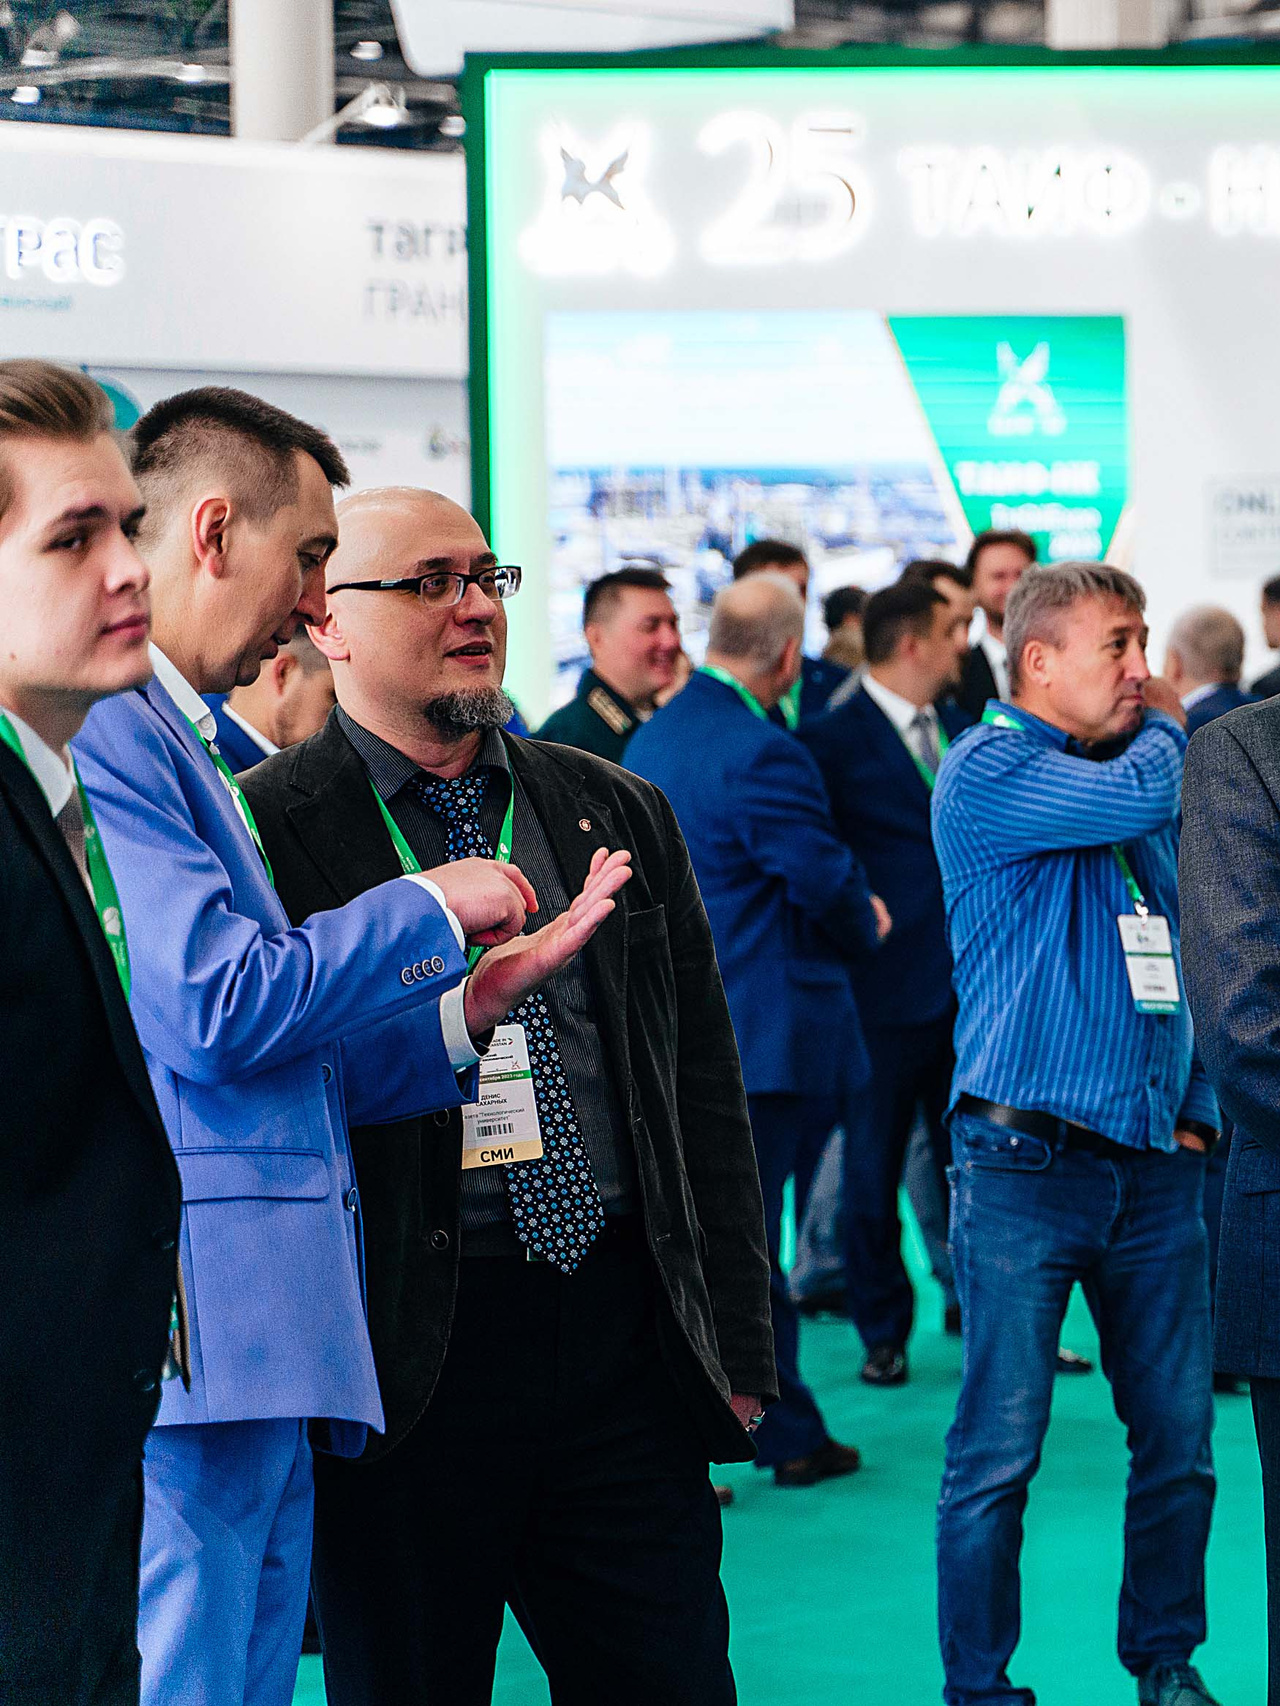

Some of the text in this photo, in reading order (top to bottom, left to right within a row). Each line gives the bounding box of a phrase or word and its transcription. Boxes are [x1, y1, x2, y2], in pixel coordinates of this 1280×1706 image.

[697, 110, 872, 262] 25
[481, 1093, 501, 1101] ДЕНИС
[480, 1147, 514, 1163] СМИ
